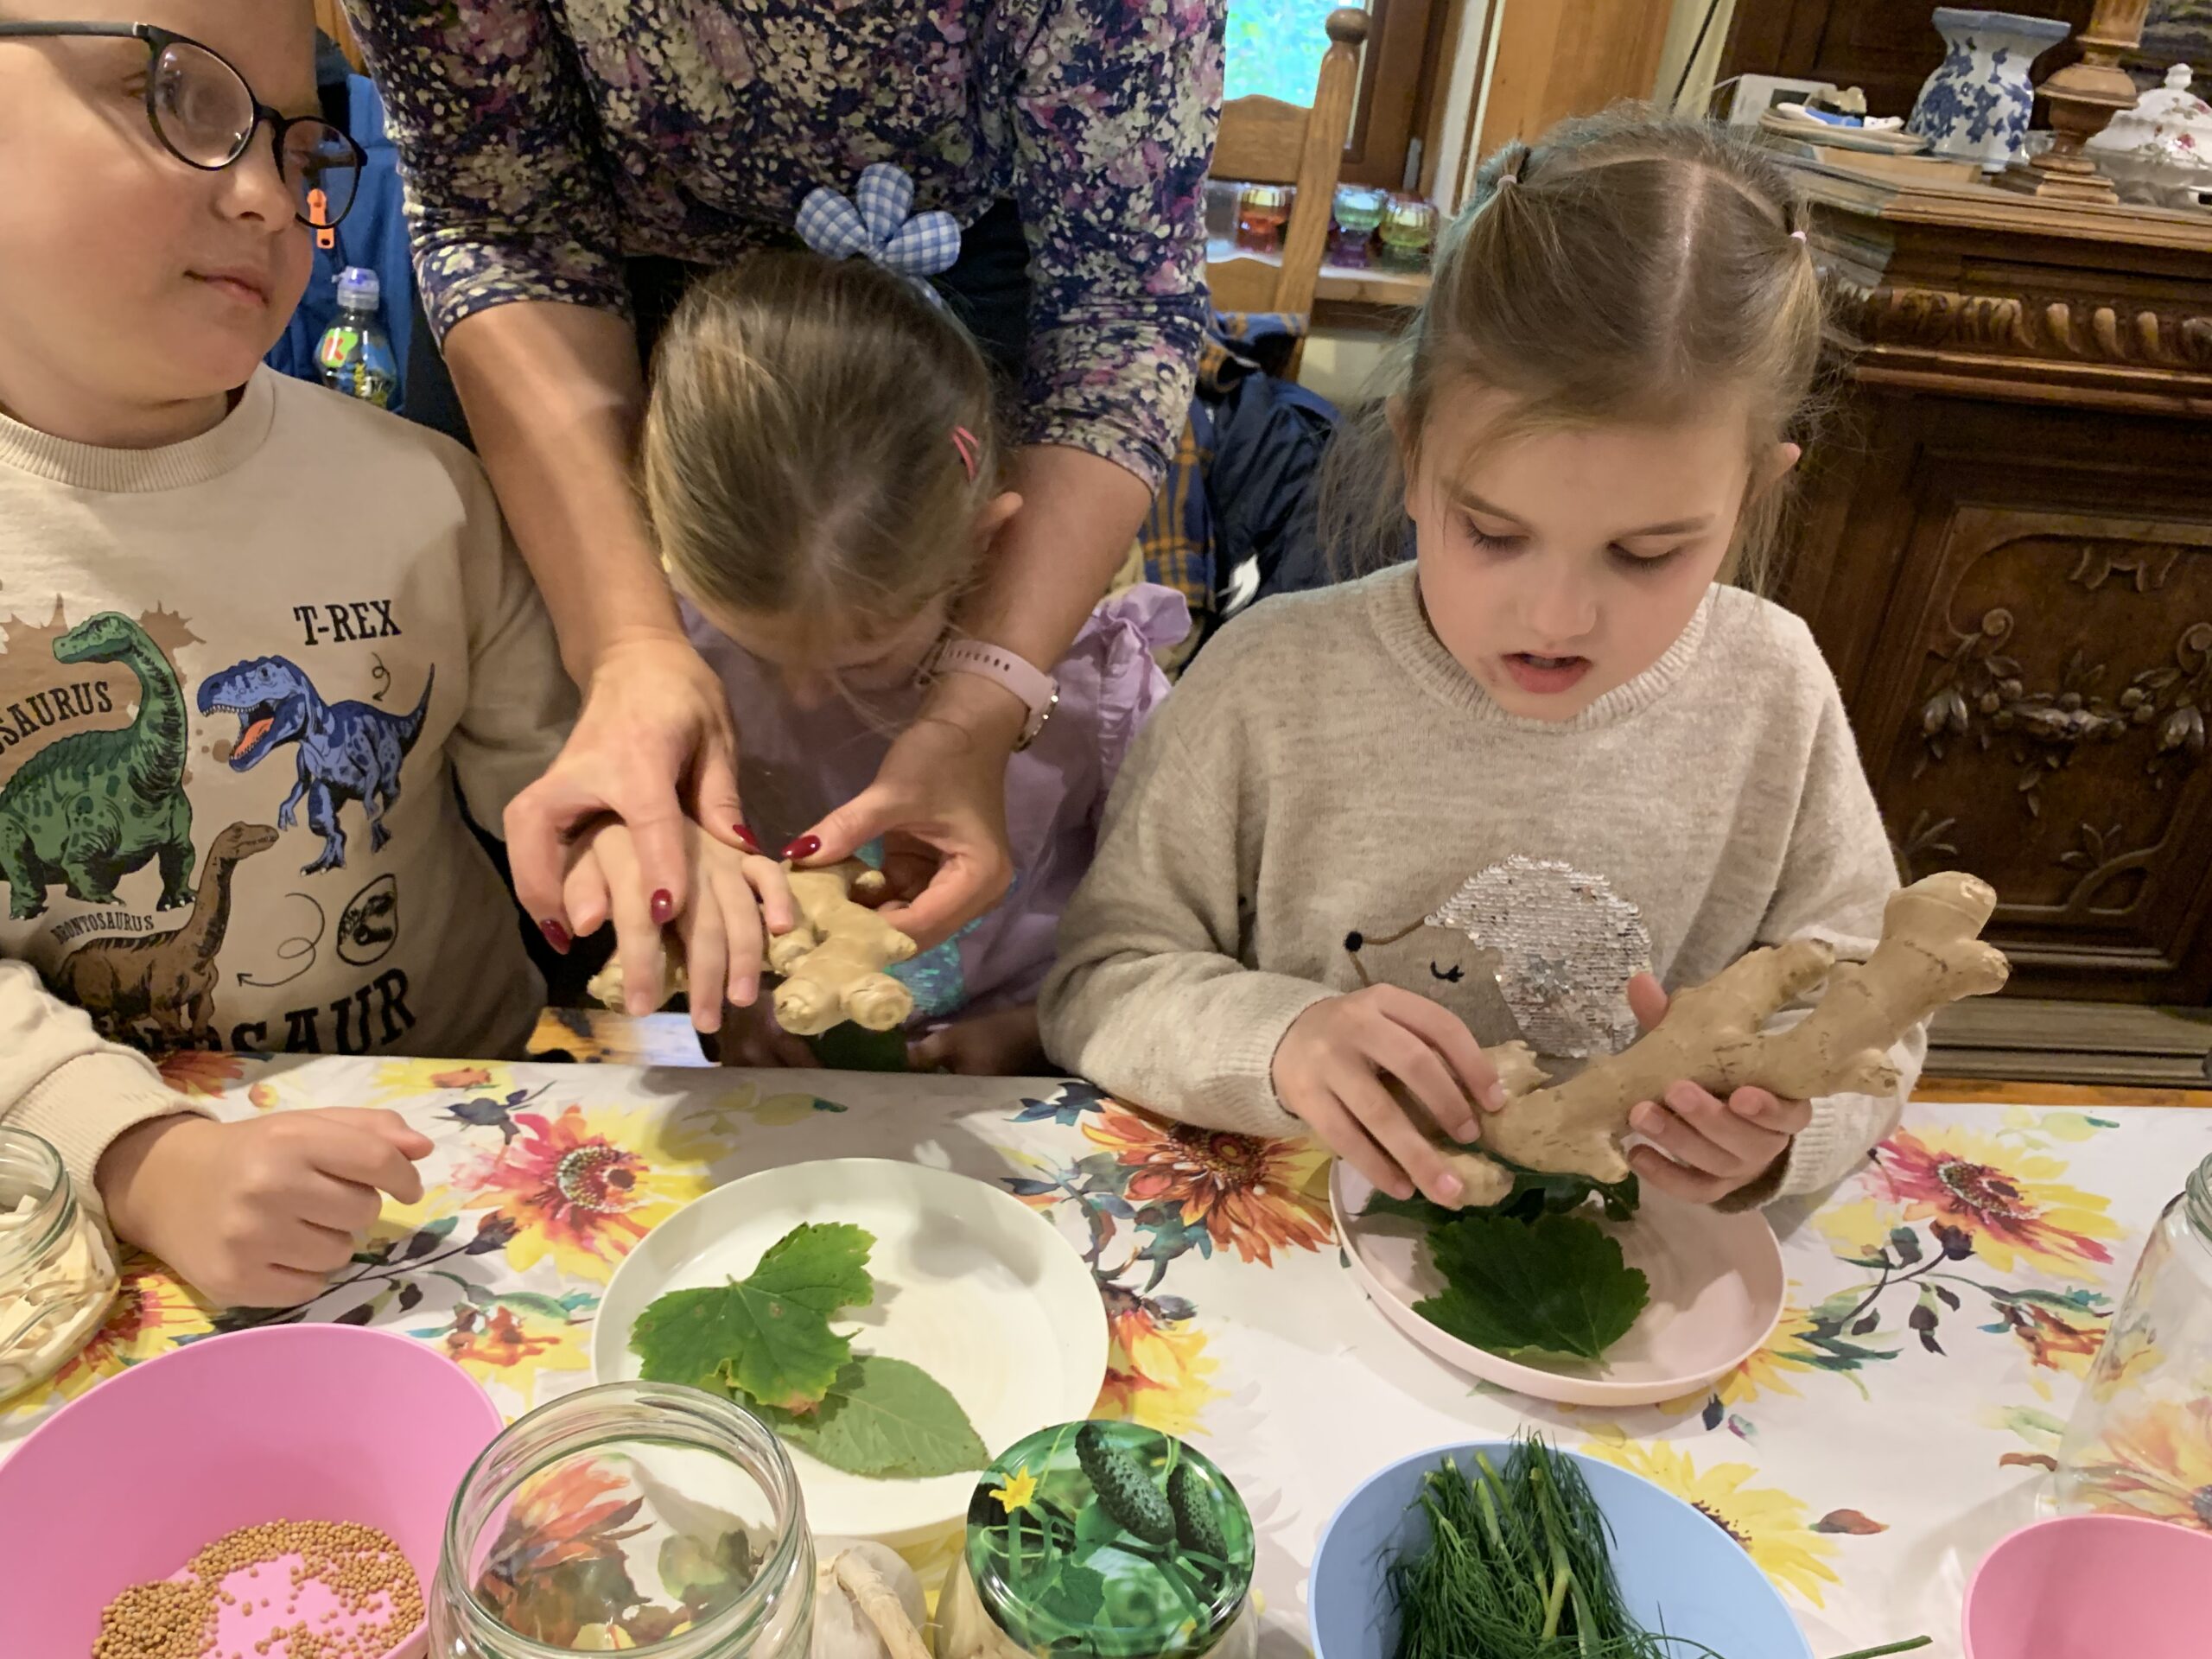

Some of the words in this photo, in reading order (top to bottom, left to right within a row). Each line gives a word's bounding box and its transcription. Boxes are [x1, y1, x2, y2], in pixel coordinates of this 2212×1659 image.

[292, 599, 403, 646] T-REX
[0, 680, 113, 755] SAURUS
[123, 967, 416, 1056] SAUR
